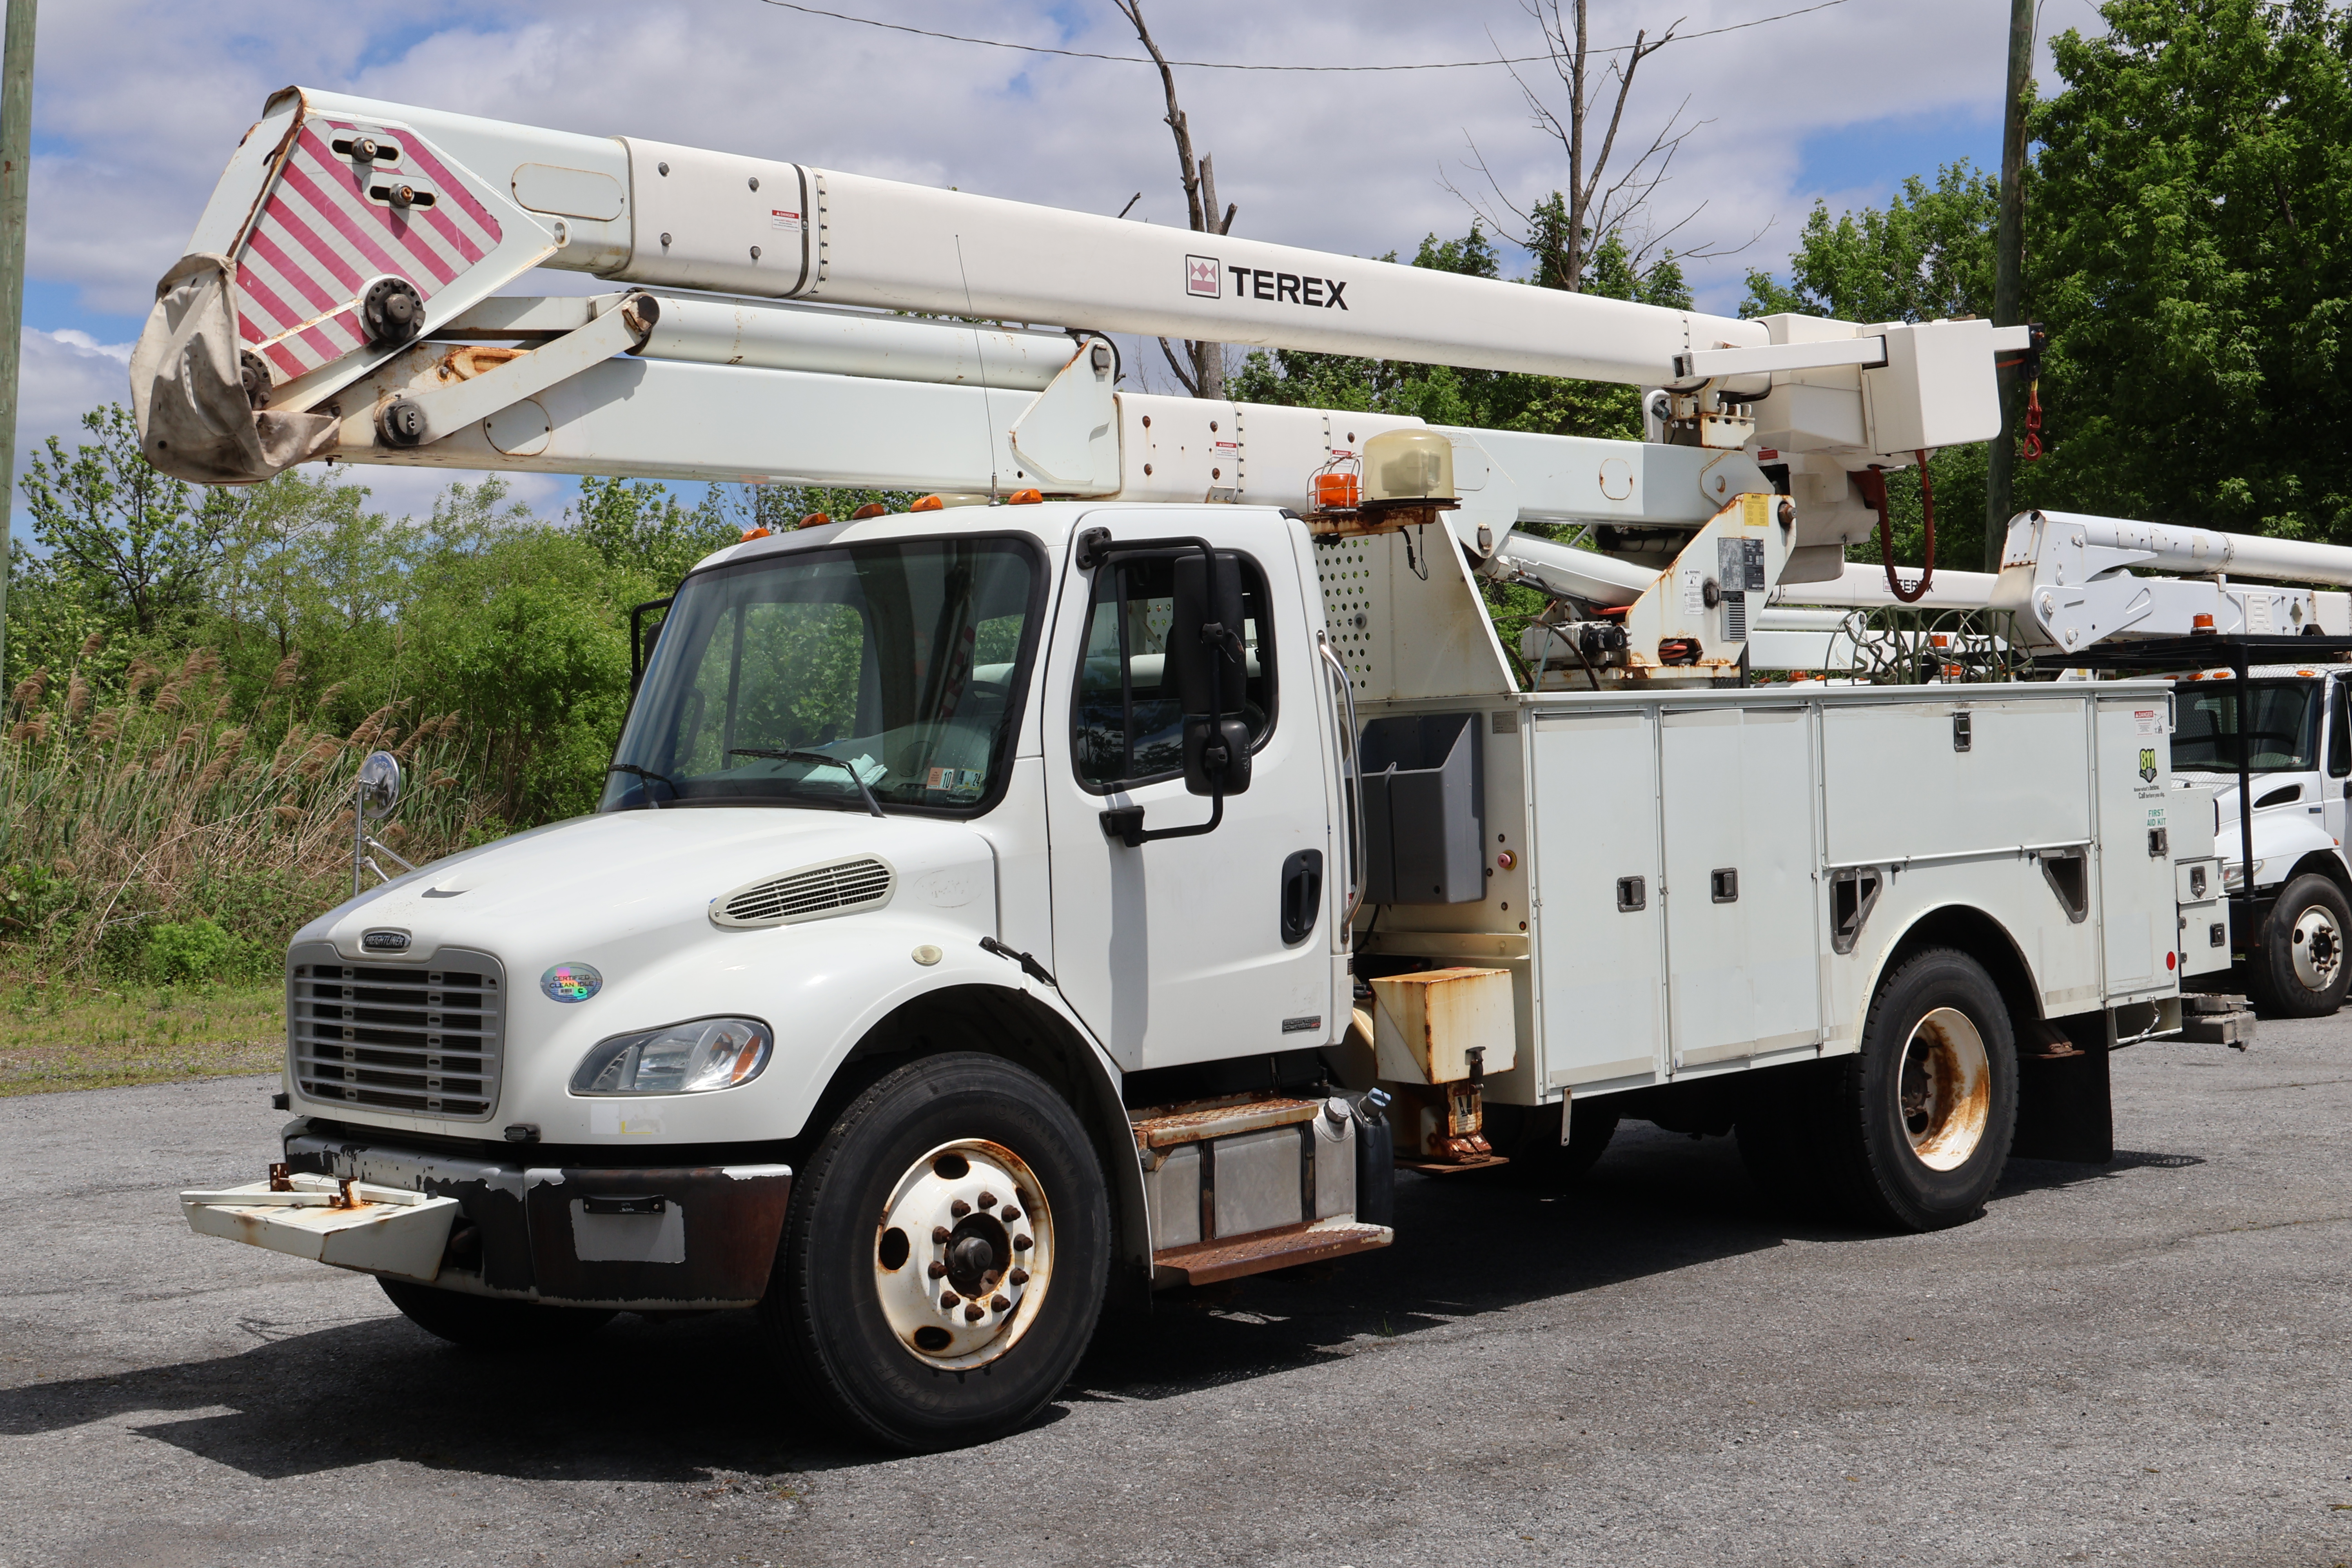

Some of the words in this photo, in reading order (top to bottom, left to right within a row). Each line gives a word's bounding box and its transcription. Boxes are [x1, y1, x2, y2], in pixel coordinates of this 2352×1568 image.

[1229, 265, 1349, 311] TEREX
[1897, 579, 1934, 592] TERX
[2140, 749, 2155, 771] 811
[942, 771, 952, 788] 10
[959, 771, 965, 784] 4
[973, 773, 981, 786] 24
[2149, 809, 2164, 817] FIRST
[2147, 818, 2156, 827] AID
[2157, 817, 2166, 826] KIT
[365, 935, 404, 946] FREIGHTLINER
[983, 1096, 1080, 1192] YOKOHAMA
[870, 1353, 958, 1414] 108R
